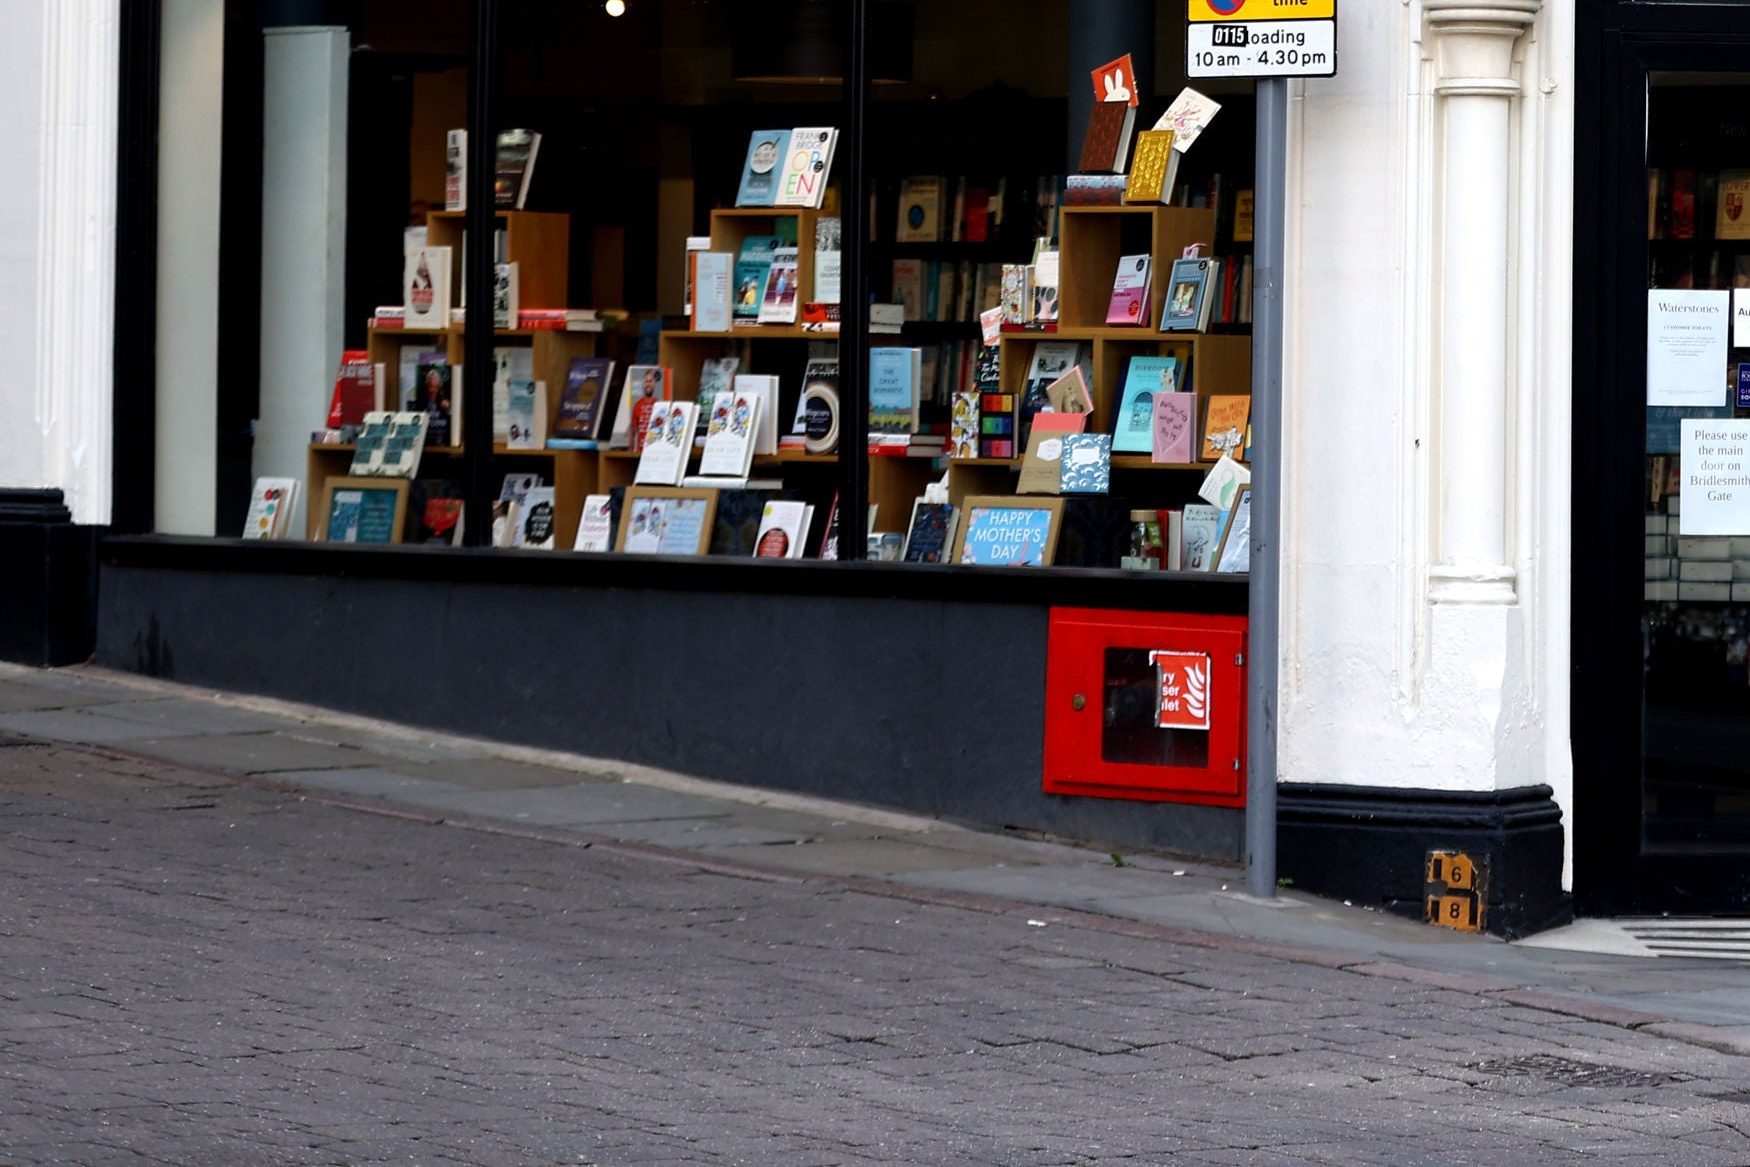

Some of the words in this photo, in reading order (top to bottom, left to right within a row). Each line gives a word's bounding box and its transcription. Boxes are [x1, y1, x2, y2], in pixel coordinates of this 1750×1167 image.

[1214, 27, 1245, 44] 0115
[786, 174, 816, 195] EN
[1658, 302, 1719, 314] Waterstones
[1694, 430, 1727, 441] Please
[1730, 432, 1748, 441] use
[1698, 445, 1714, 455] the
[1717, 445, 1743, 456] main
[1700, 460, 1725, 471] door
[1727, 463, 1741, 471] on
[1690, 475, 1750, 487] Bridlesmith
[1707, 491, 1732, 502] Gate
[989, 511, 1034, 526] HAPPY
[974, 527, 1041, 543] MOTHER'S
[991, 545, 1020, 559] DAY
[1163, 672, 1175, 685] ry
[1162, 686, 1180, 696] ser
[1161, 699, 1180, 711] let
[1451, 866, 1462, 883] 6
[1449, 902, 1460, 919] 8
